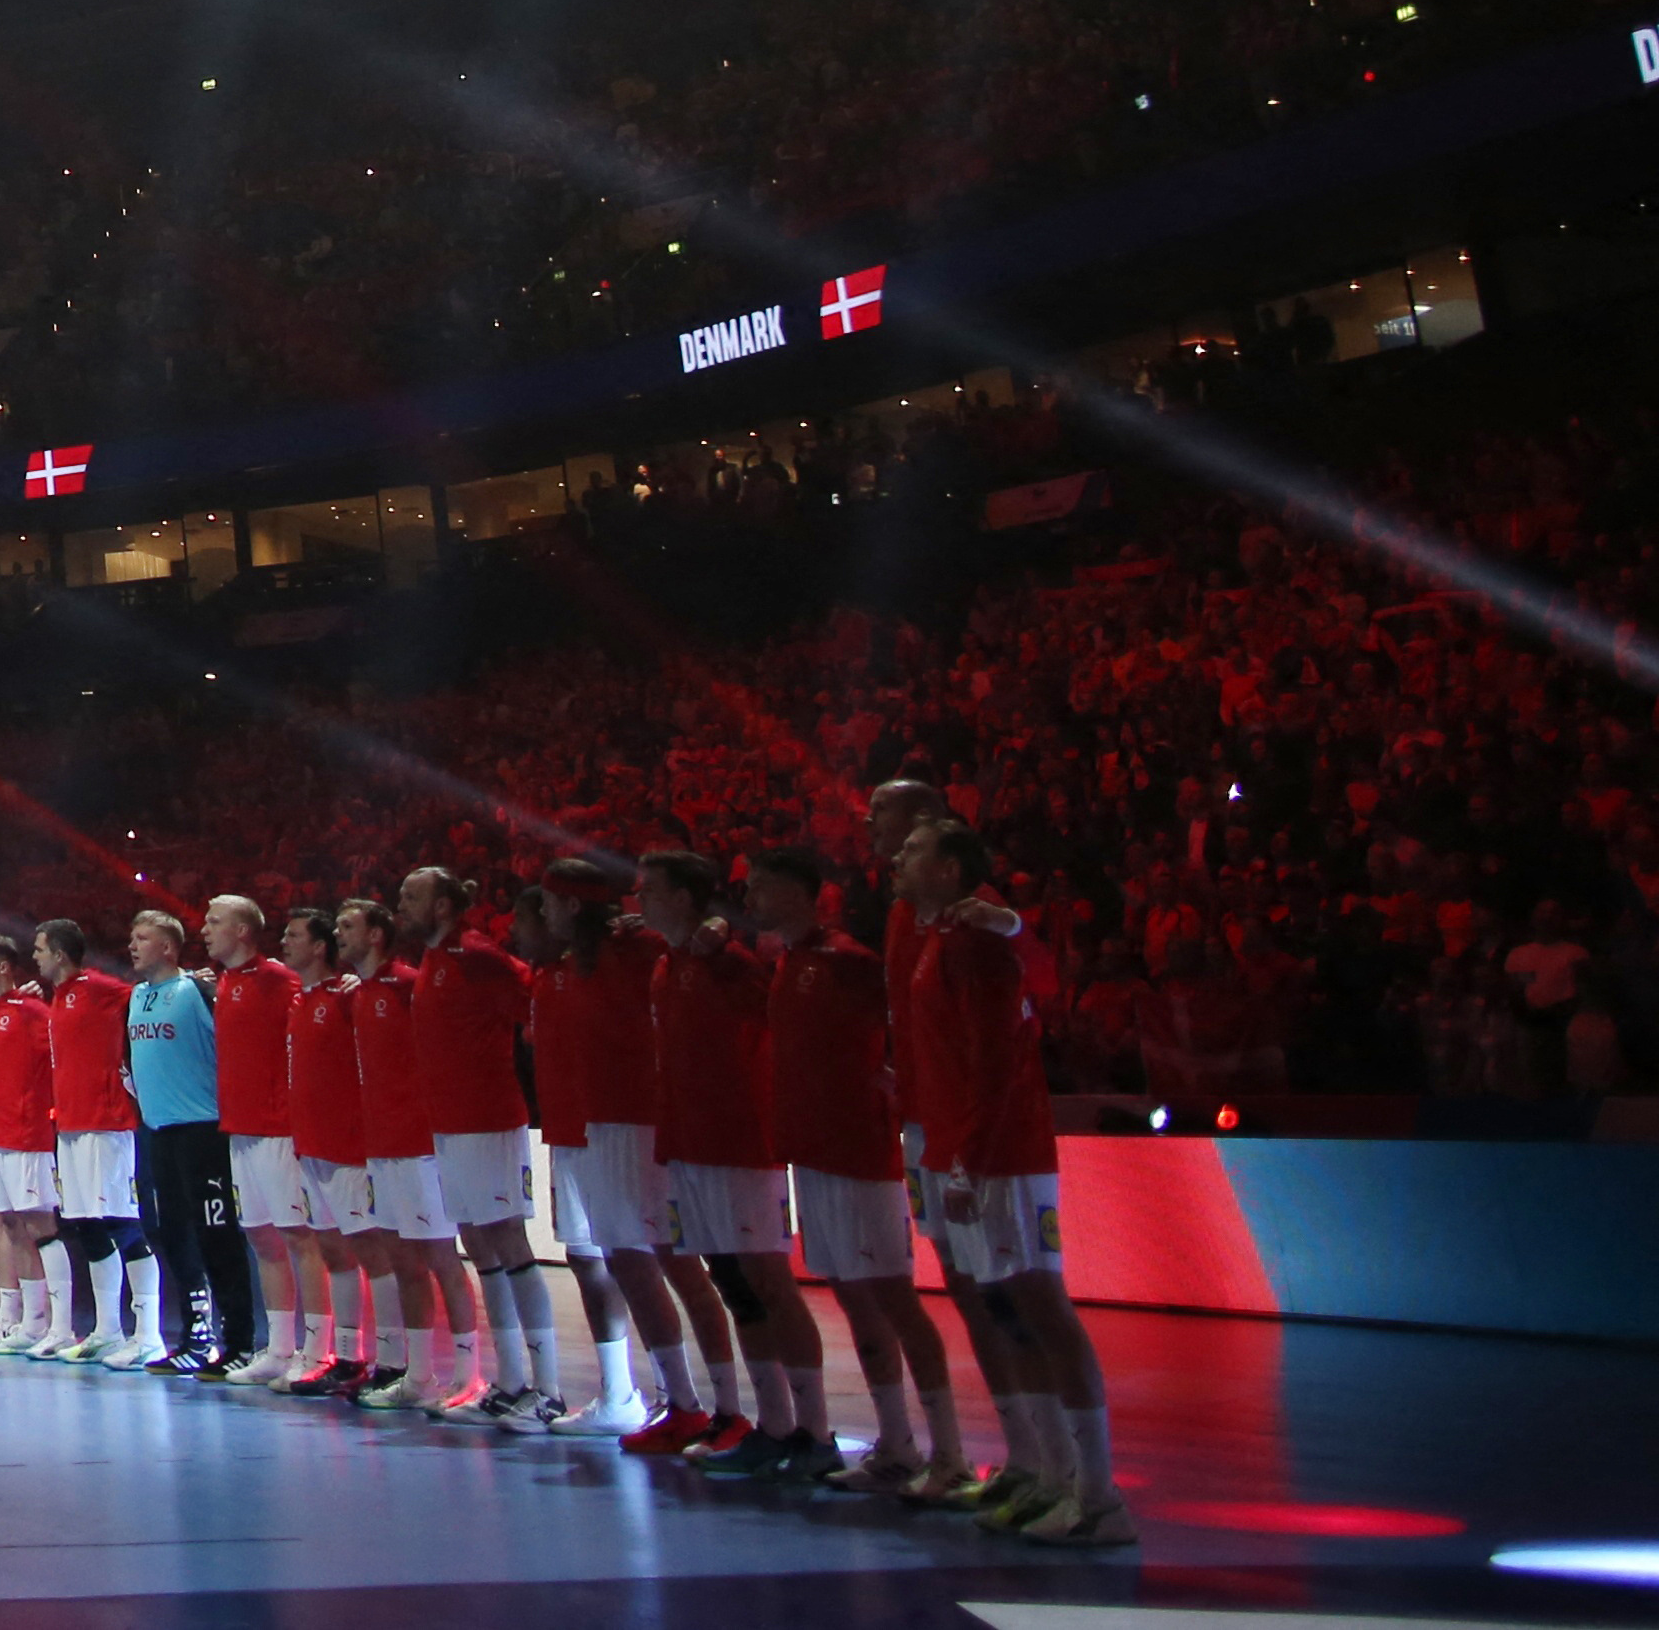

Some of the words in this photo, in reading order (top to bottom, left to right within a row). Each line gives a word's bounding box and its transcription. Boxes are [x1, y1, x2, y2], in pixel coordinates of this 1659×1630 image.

[680, 305, 785, 373] DENMARK
[142, 991, 159, 1013] 12
[204, 1199, 226, 1226] 12
